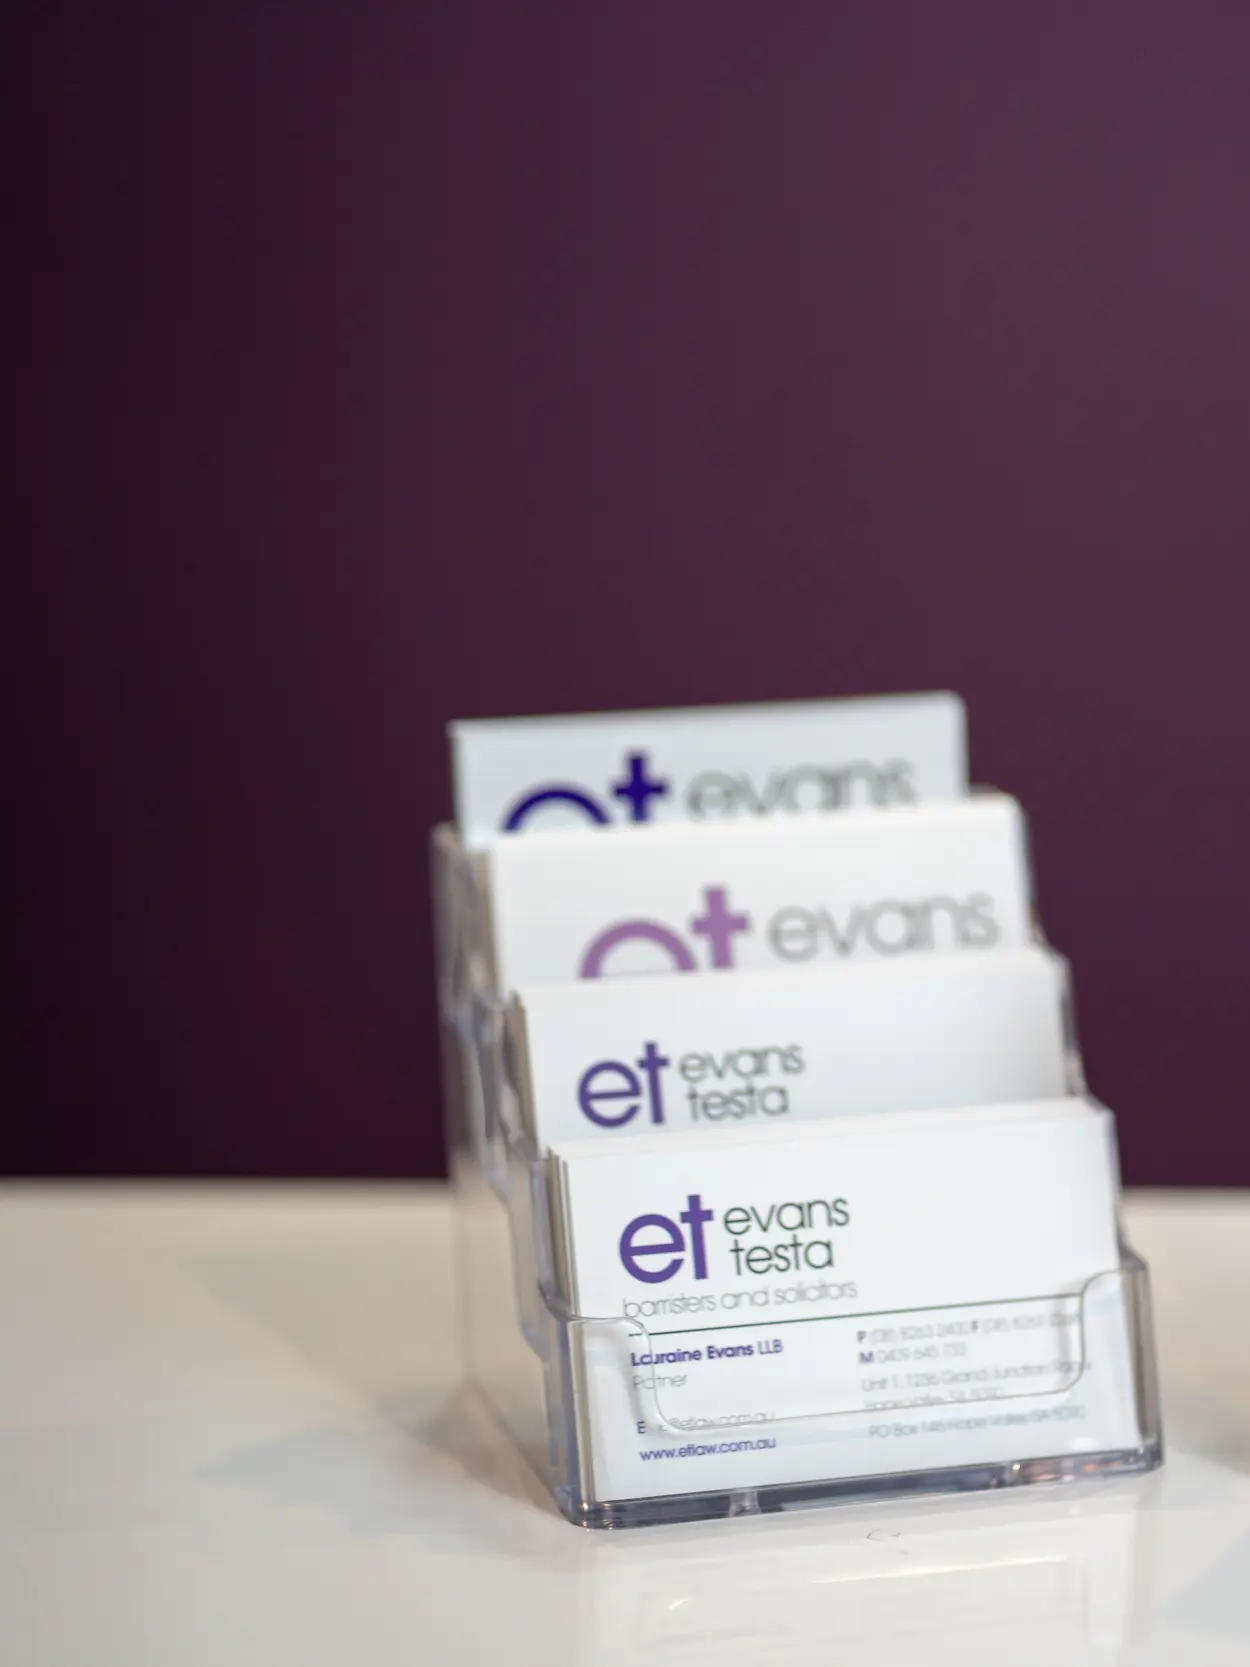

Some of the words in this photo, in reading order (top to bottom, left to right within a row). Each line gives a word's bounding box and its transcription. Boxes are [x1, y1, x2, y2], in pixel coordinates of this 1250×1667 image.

[686, 757, 917, 821] evans
[767, 892, 1003, 963] evans
[679, 1043, 805, 1082] evans
[577, 1041, 670, 1128] et
[686, 1082, 790, 1121] testa
[723, 1196, 851, 1236] evans
[619, 1194, 714, 1284] et
[729, 1232, 835, 1276] testa
[622, 1292, 717, 1318] barristers
[720, 1284, 770, 1310] and
[773, 1279, 859, 1305] solicitors
[706, 1344, 755, 1360] Evans
[757, 1338, 784, 1356] LLB
[858, 1351, 875, 1364] M
[637, 1421, 647, 1434] E
[868, 1424, 891, 1438] PO
[640, 1437, 778, 1462] www.etlaw.com.au
